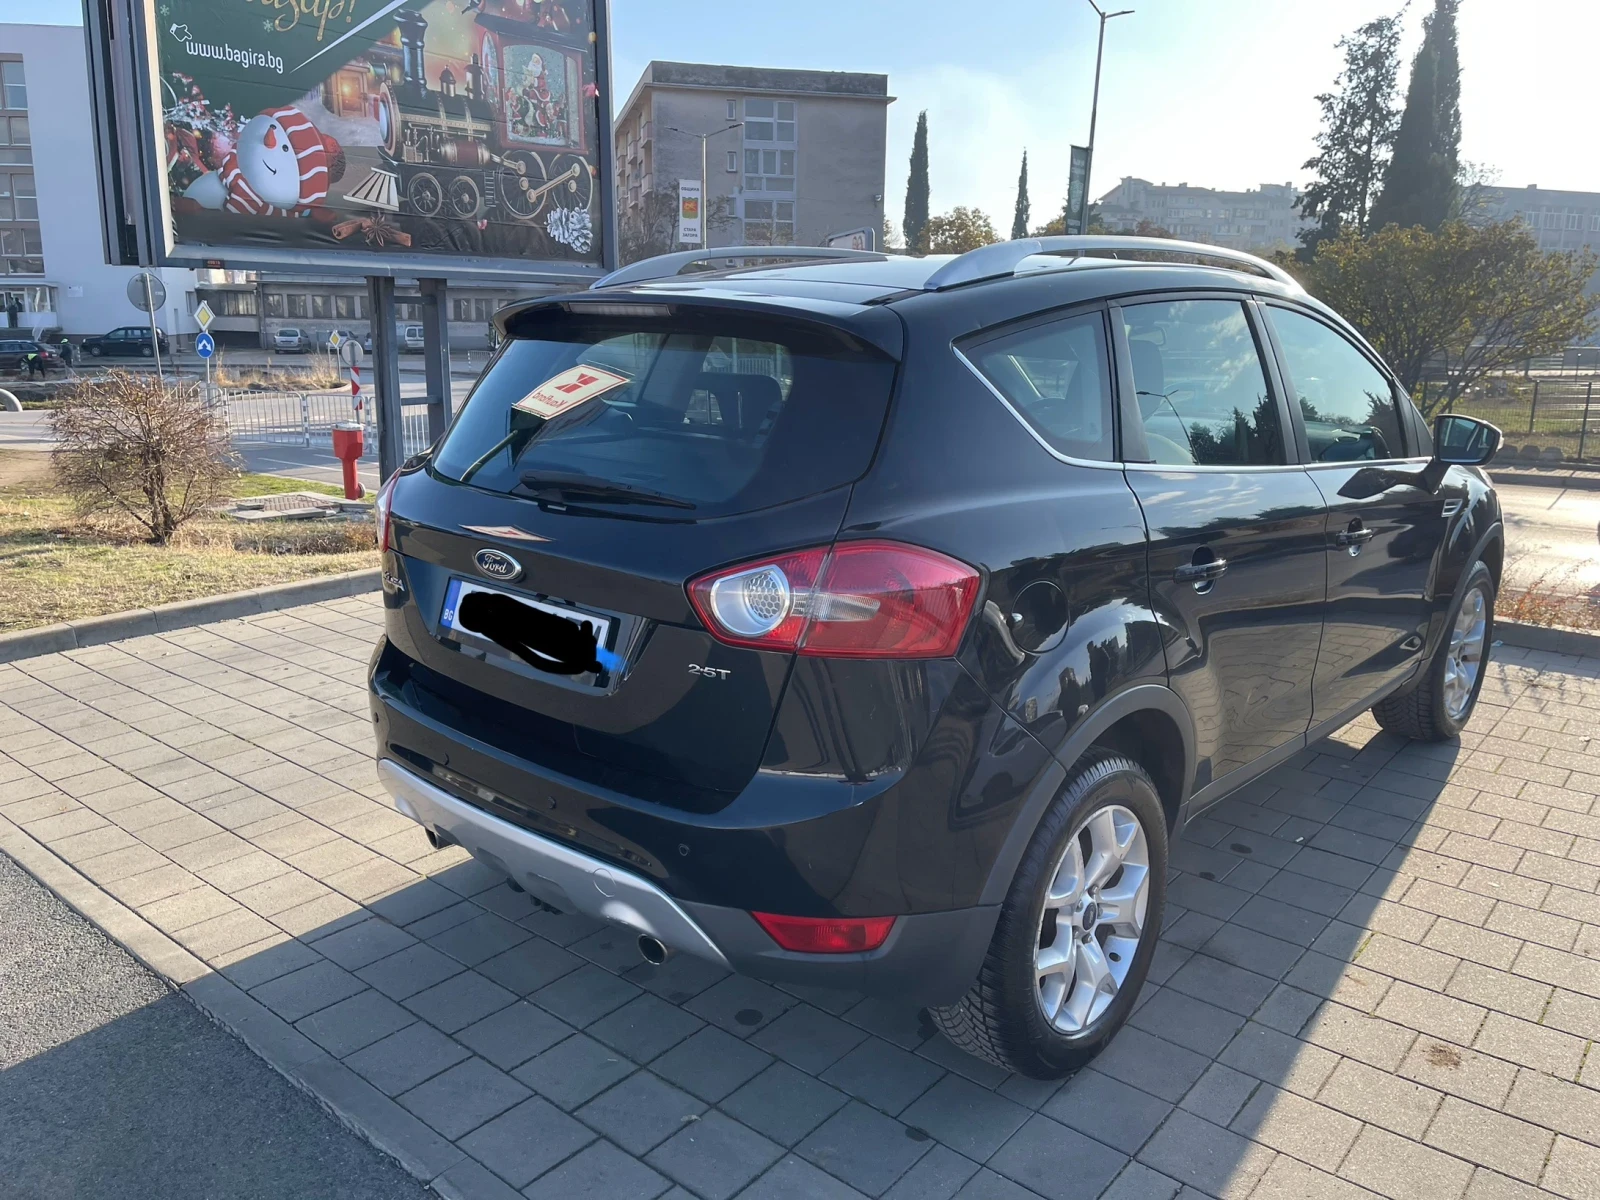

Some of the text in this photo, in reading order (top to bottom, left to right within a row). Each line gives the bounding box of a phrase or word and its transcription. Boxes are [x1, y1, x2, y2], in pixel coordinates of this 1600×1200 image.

[185, 41, 284, 74] www.bagira.bg
[482, 553, 508, 574] Ford
[443, 608, 454, 621] BG
